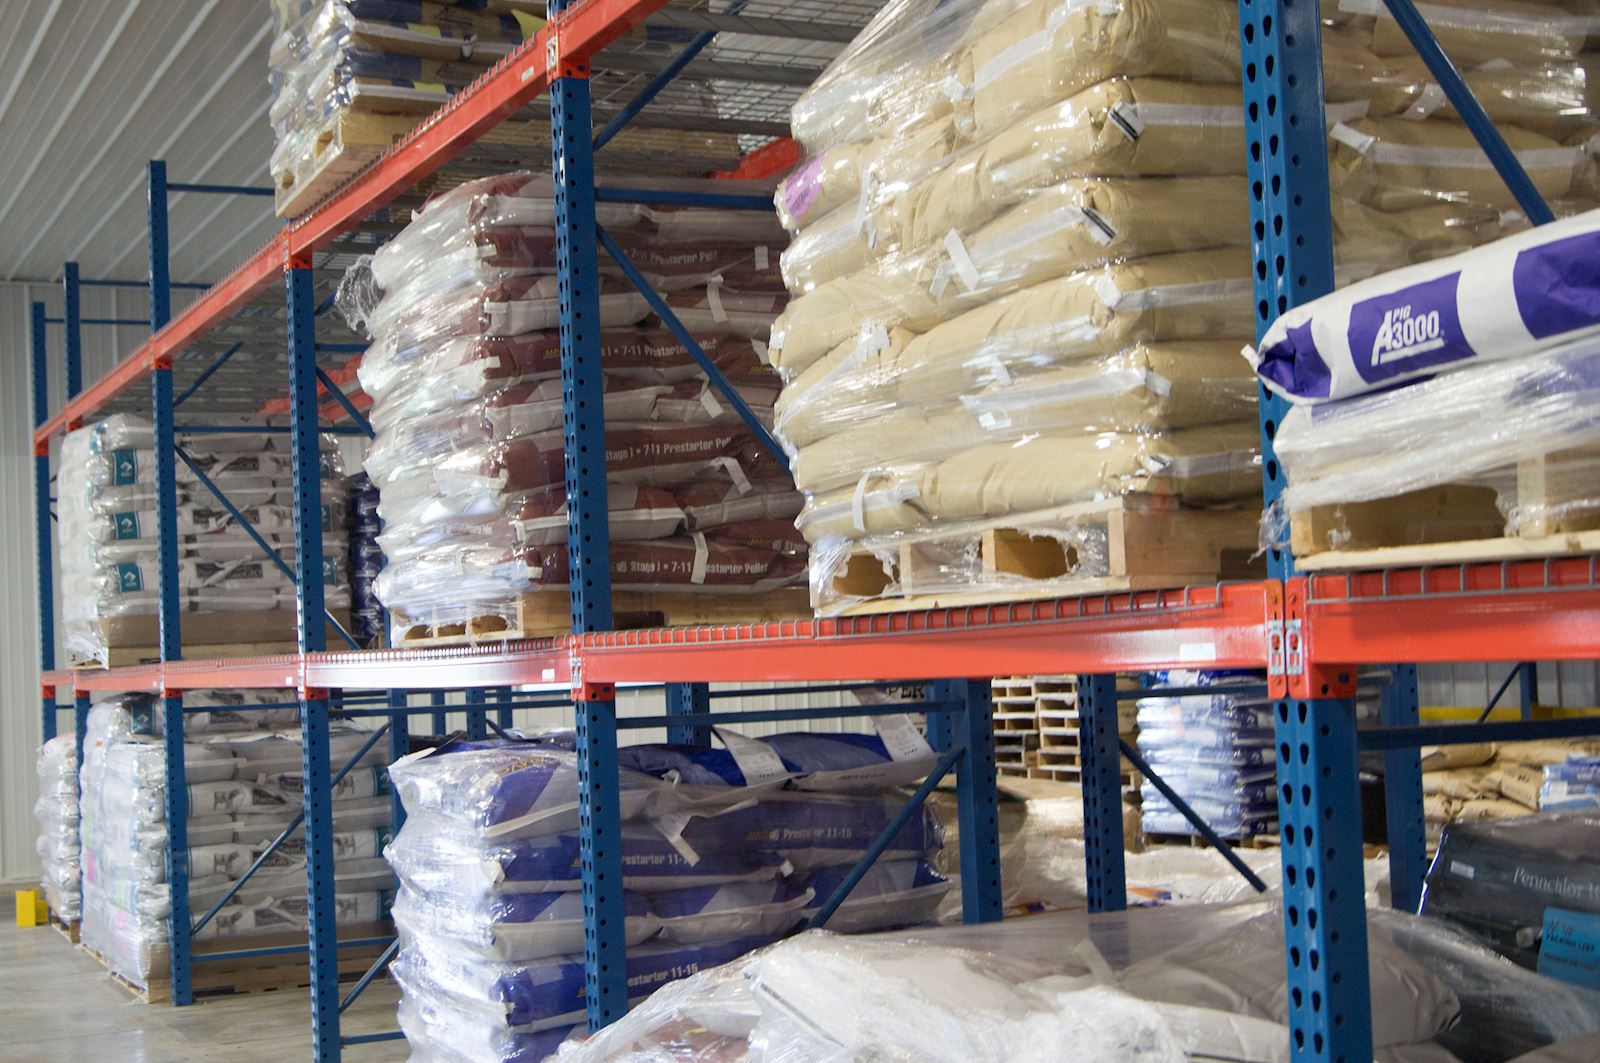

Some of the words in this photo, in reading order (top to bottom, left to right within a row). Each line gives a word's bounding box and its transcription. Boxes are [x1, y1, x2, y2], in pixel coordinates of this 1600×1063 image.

[622, 343, 643, 357] 7-11
[643, 443, 661, 456] 7-11
[663, 439, 714, 455] Prestarter
[630, 561, 656, 573] Stage
[671, 560, 692, 573] 7-11
[704, 563, 743, 575] estarter
[744, 561, 768, 575] Pellet
[621, 853, 666, 866] restarter
[627, 969, 669, 988] estarter
[670, 961, 699, 980] 11-15
